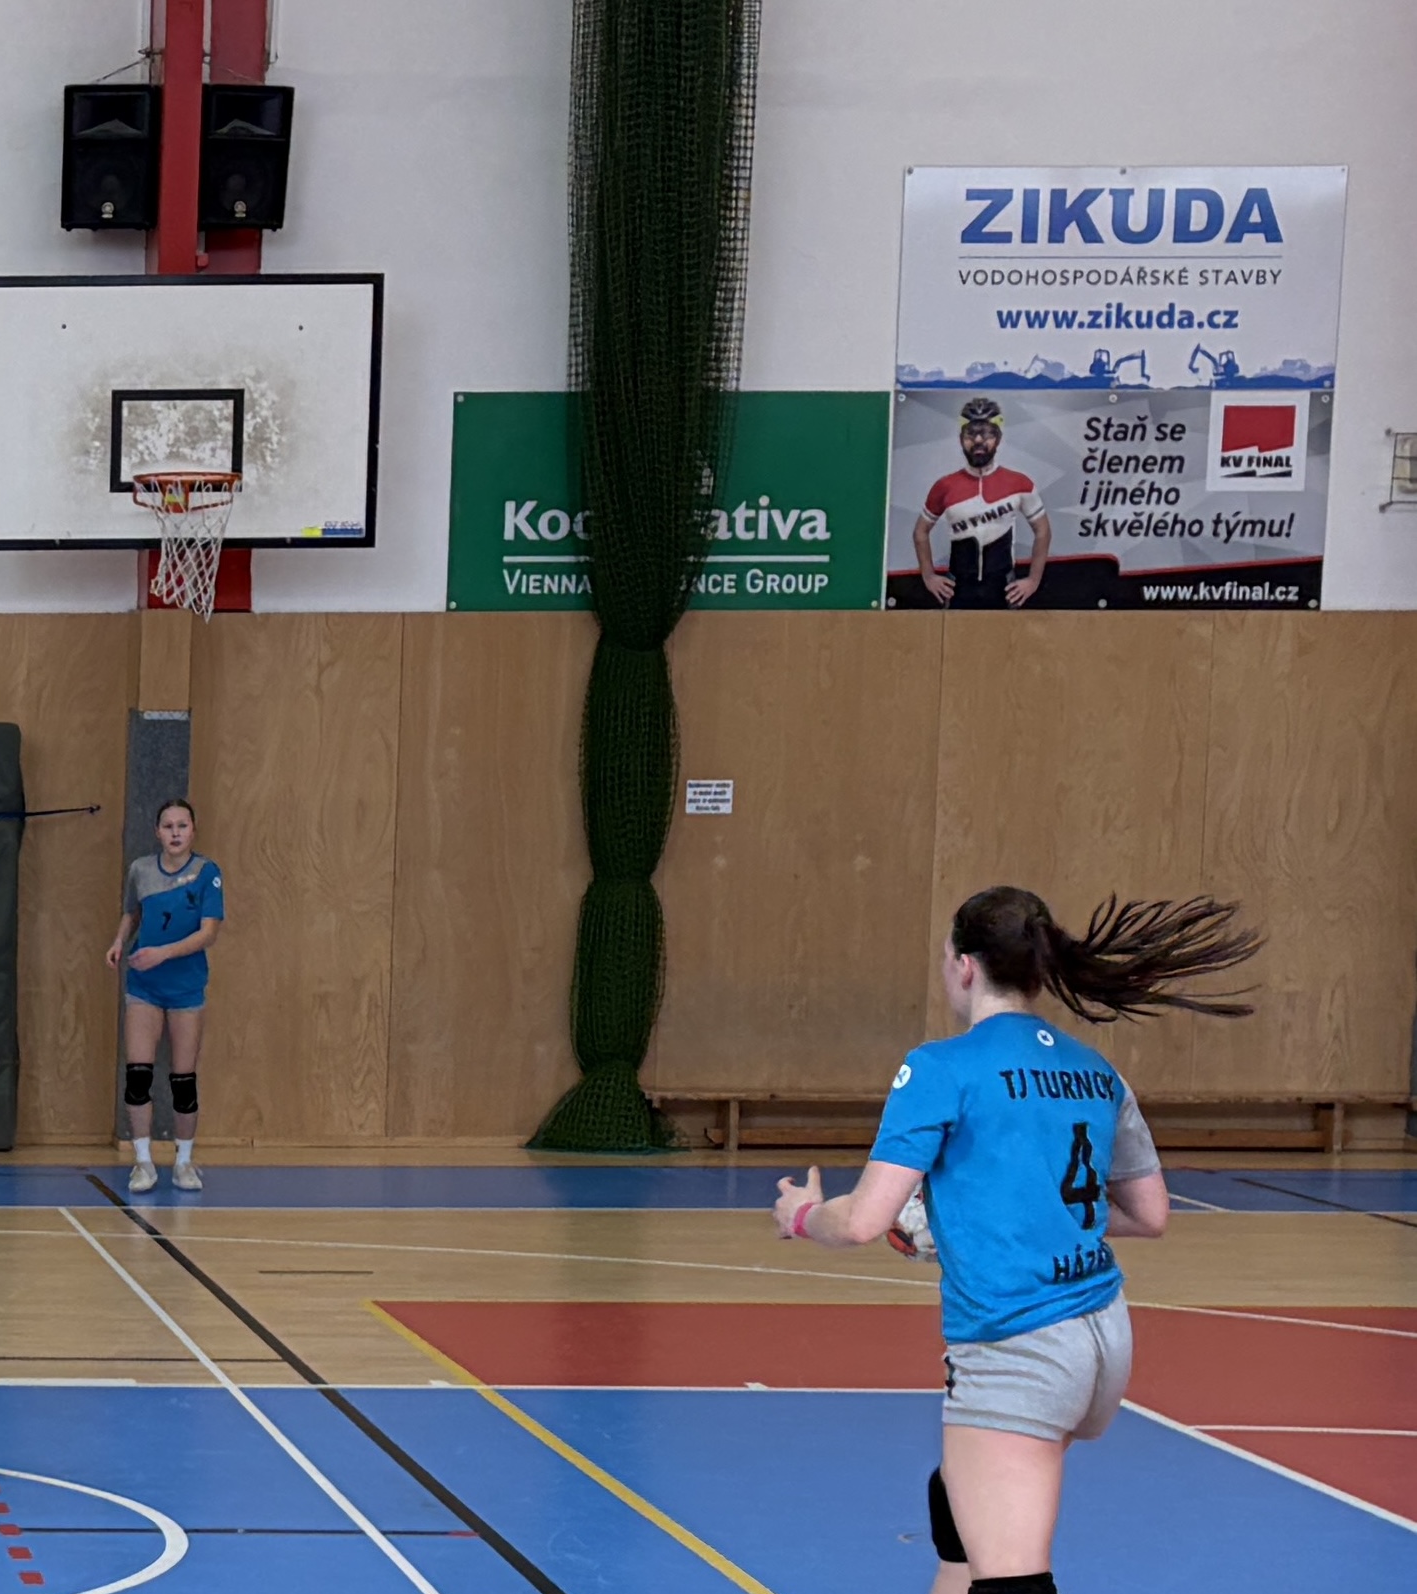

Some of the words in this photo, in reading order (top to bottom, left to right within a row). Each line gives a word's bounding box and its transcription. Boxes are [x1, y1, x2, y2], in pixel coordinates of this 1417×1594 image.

[960, 187, 1284, 244] ZIKUDA
[958, 265, 1189, 286] VODOHOSPODÁŘSKÉ
[1199, 268, 1283, 286] STAVBY
[996, 303, 1239, 330] www.zikuda.cz
[1084, 416, 1147, 442] Staň
[1155, 422, 1186, 442] se
[1082, 448, 1185, 474] členem
[1220, 455, 1245, 467] KV
[1248, 455, 1292, 468] FINAL
[1079, 480, 1089, 506] i
[1093, 480, 1180, 511] jiného
[503, 495, 831, 541] Kooativa
[1078, 512, 1204, 539] skvělého
[1212, 513, 1296, 544] týmu!
[502, 569, 592, 595] VIENNA
[746, 568, 829, 594] GROUP
[1143, 582, 1300, 602] www.kvfinal.cz
[999, 1068, 1028, 1100] TJ
[1059, 1121, 1102, 1231] 4
